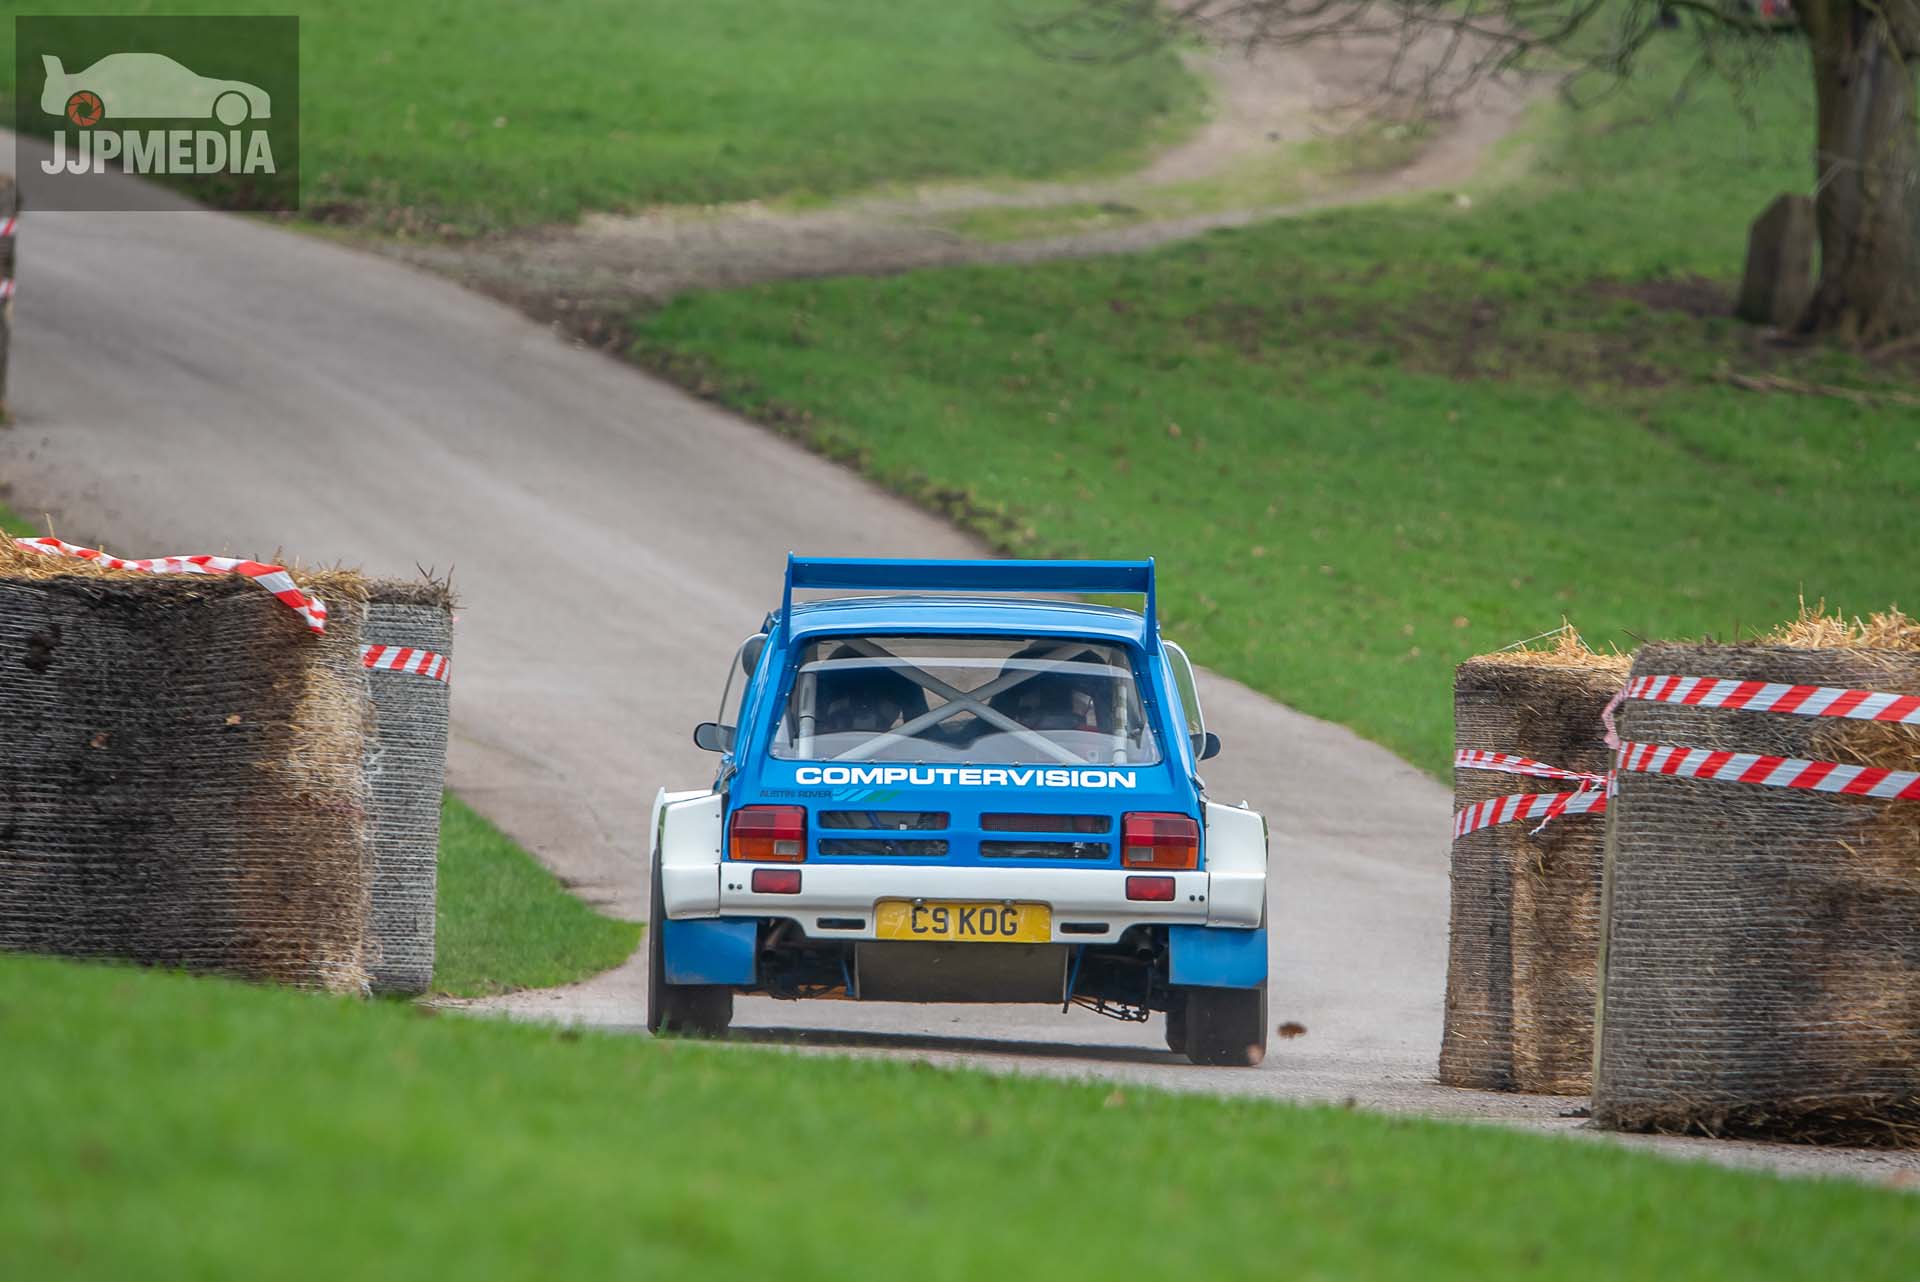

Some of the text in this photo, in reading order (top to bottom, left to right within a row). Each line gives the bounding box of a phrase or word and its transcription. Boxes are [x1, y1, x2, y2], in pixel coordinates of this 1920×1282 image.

[795, 767, 1136, 788] COMPUTERVISION
[799, 790, 832, 798] ROVER
[912, 906, 1018, 936] C9 KOG
